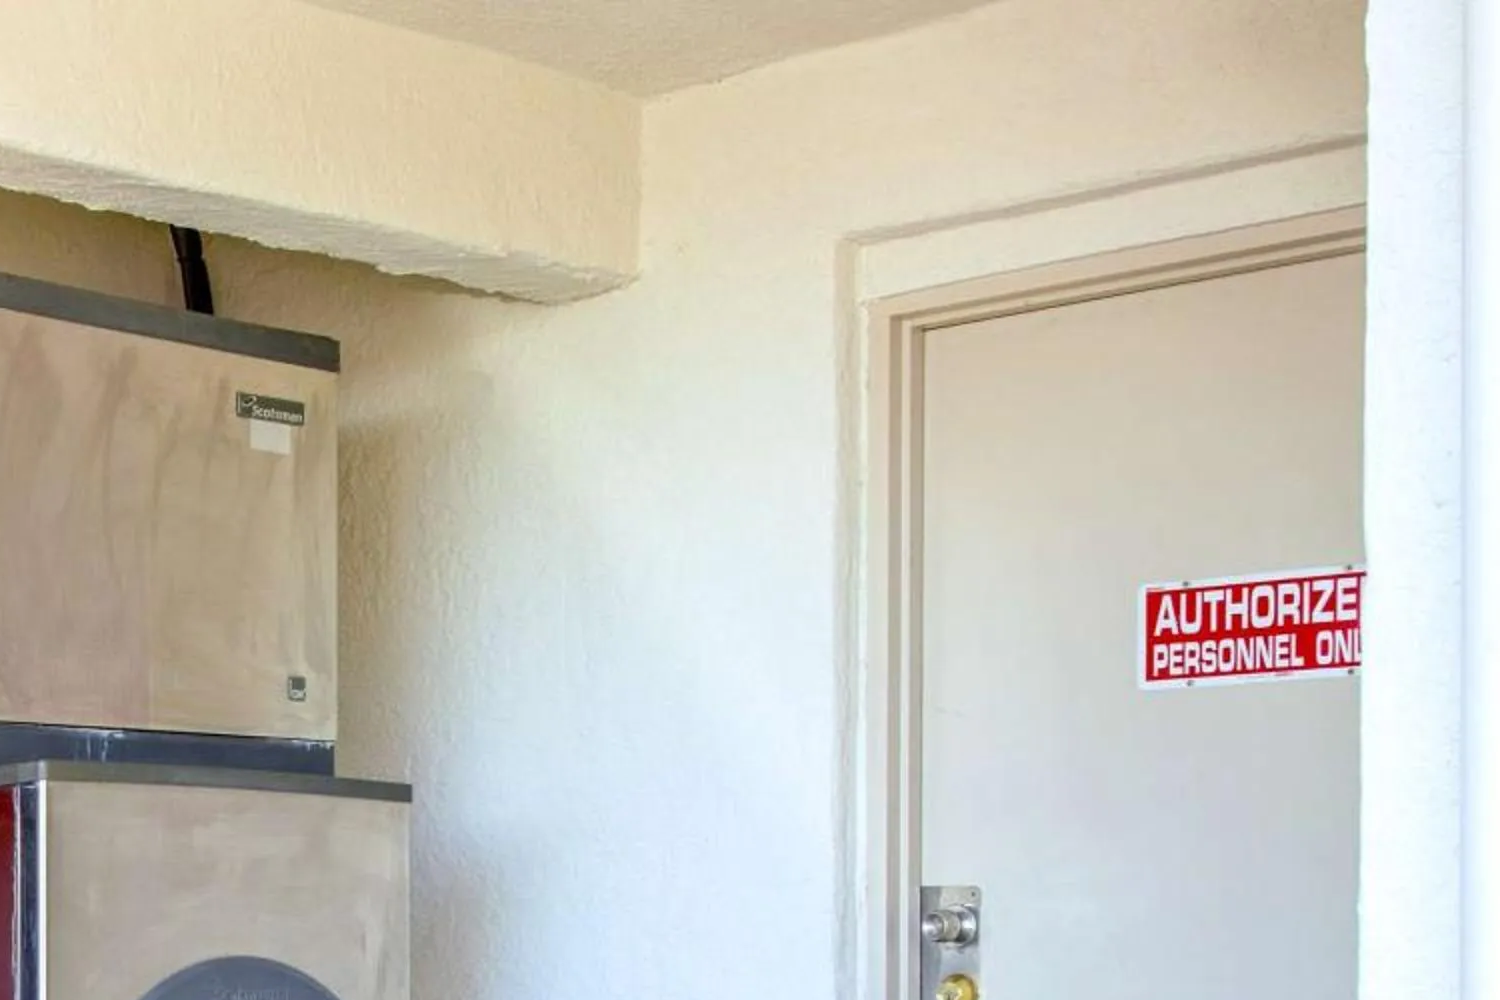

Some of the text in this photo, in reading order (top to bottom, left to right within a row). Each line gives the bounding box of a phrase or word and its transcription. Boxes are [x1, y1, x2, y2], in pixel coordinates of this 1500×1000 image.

[1153, 576, 1358, 637] AUTHORIZE
[1153, 628, 1361, 677] PERSONNEL ONL
